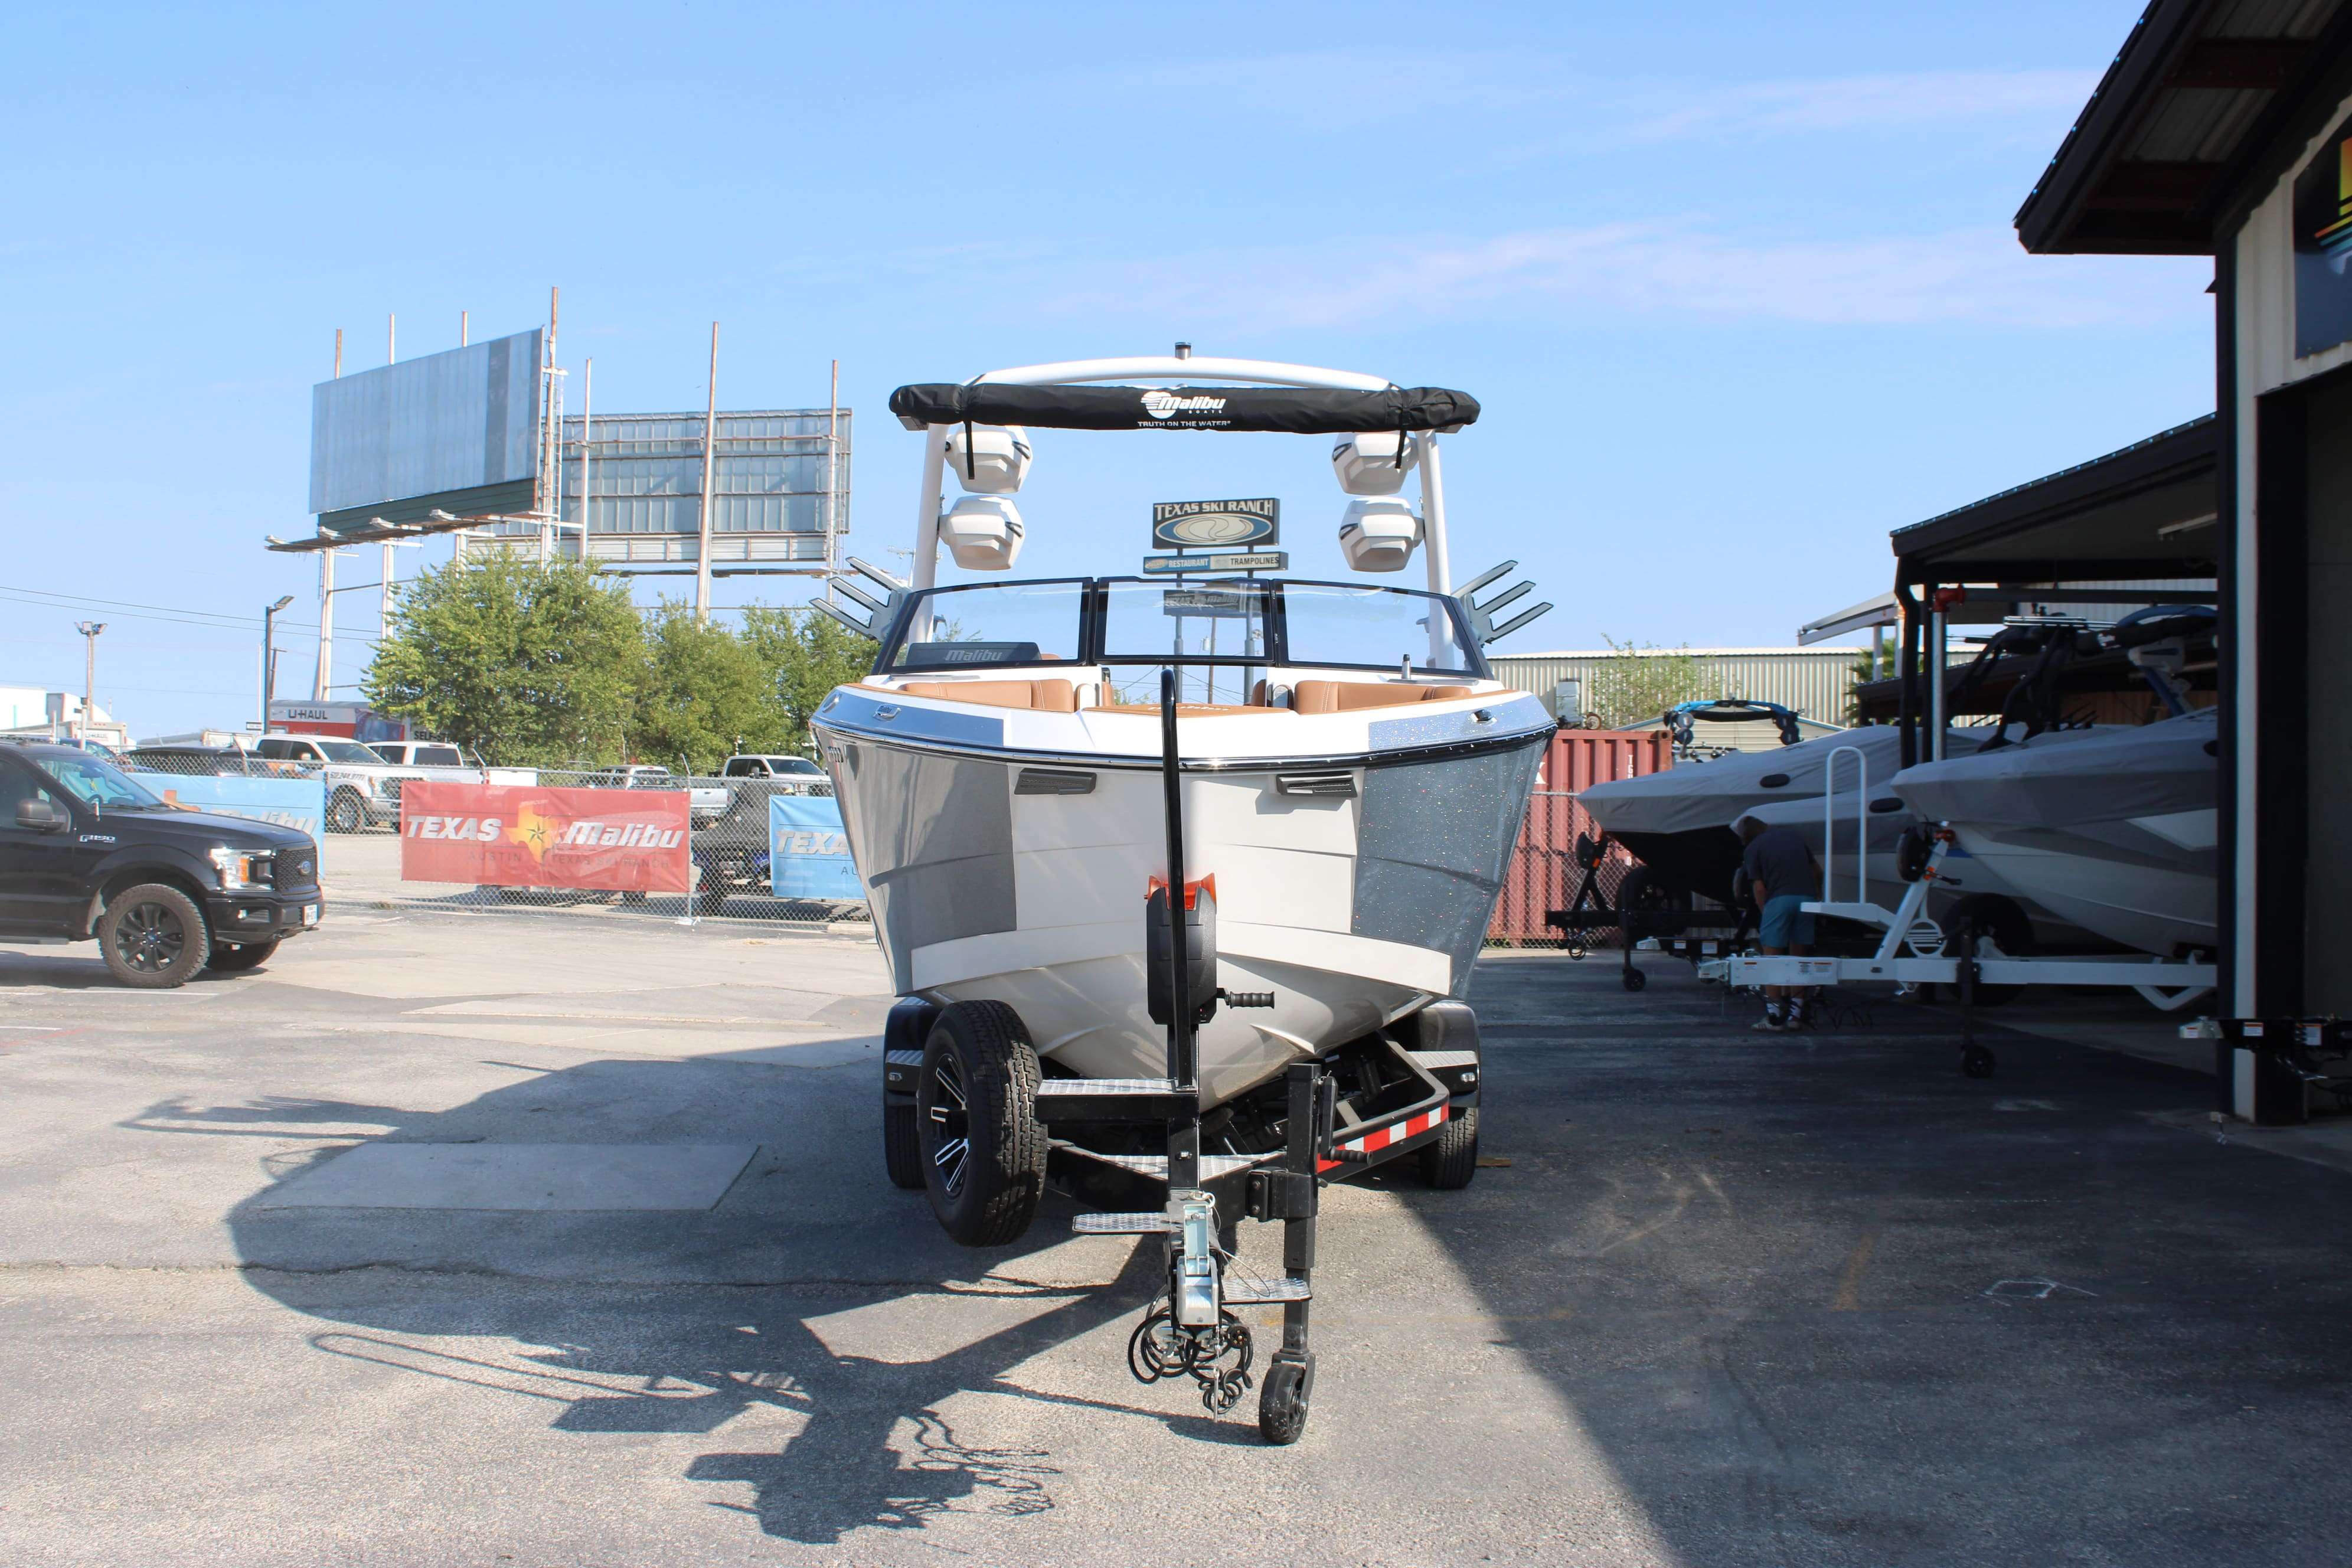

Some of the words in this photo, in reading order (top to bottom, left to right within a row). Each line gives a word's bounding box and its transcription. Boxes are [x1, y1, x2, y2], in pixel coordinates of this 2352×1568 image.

[1158, 396, 1226, 410] Malibu
[1154, 502, 1199, 521] TEXAS
[1202, 501, 1224, 512] SKI
[1227, 499, 1274, 517] RANCH
[1168, 558, 1209, 568] RESTAURANT
[1230, 556, 1280, 565] TRAMPOLINES
[945, 649, 1002, 661] Malibu
[288, 708, 328, 720] U-HAUL
[406, 815, 502, 842] TEXAS
[561, 821, 684, 849] Malibu
[776, 831, 849, 855] TEXA
[469, 851, 521, 862] AUSTIN
[552, 854, 590, 865] TEXAS
